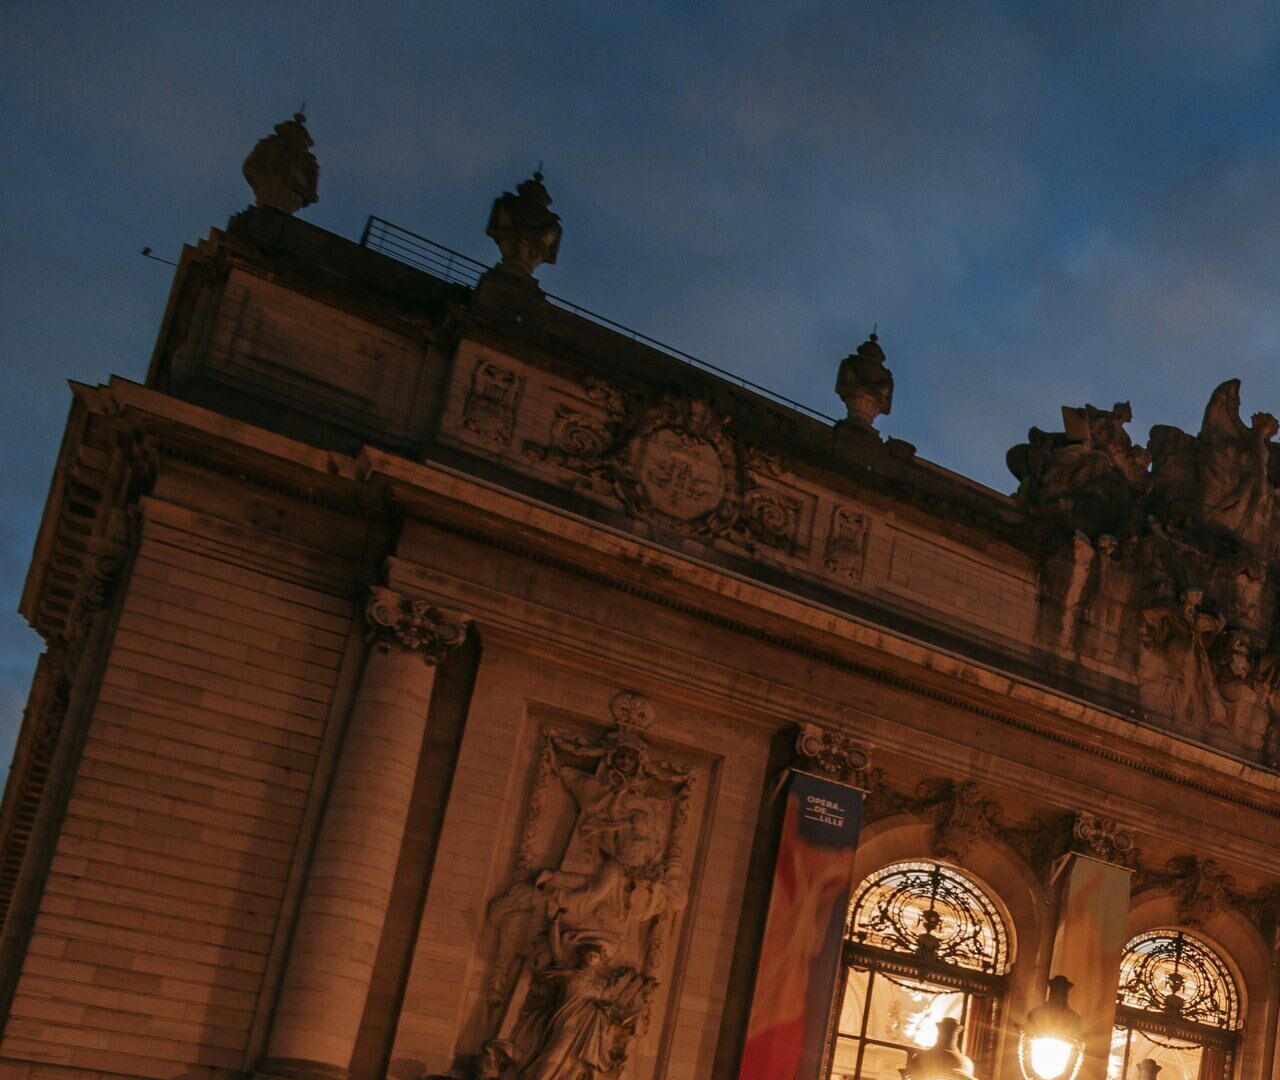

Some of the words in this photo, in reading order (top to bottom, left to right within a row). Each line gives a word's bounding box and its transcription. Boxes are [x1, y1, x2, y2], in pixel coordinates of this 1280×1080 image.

[807, 795, 839, 810] OPÉRA
[814, 805, 827, 815] DE
[820, 814, 844, 828] LILLE
